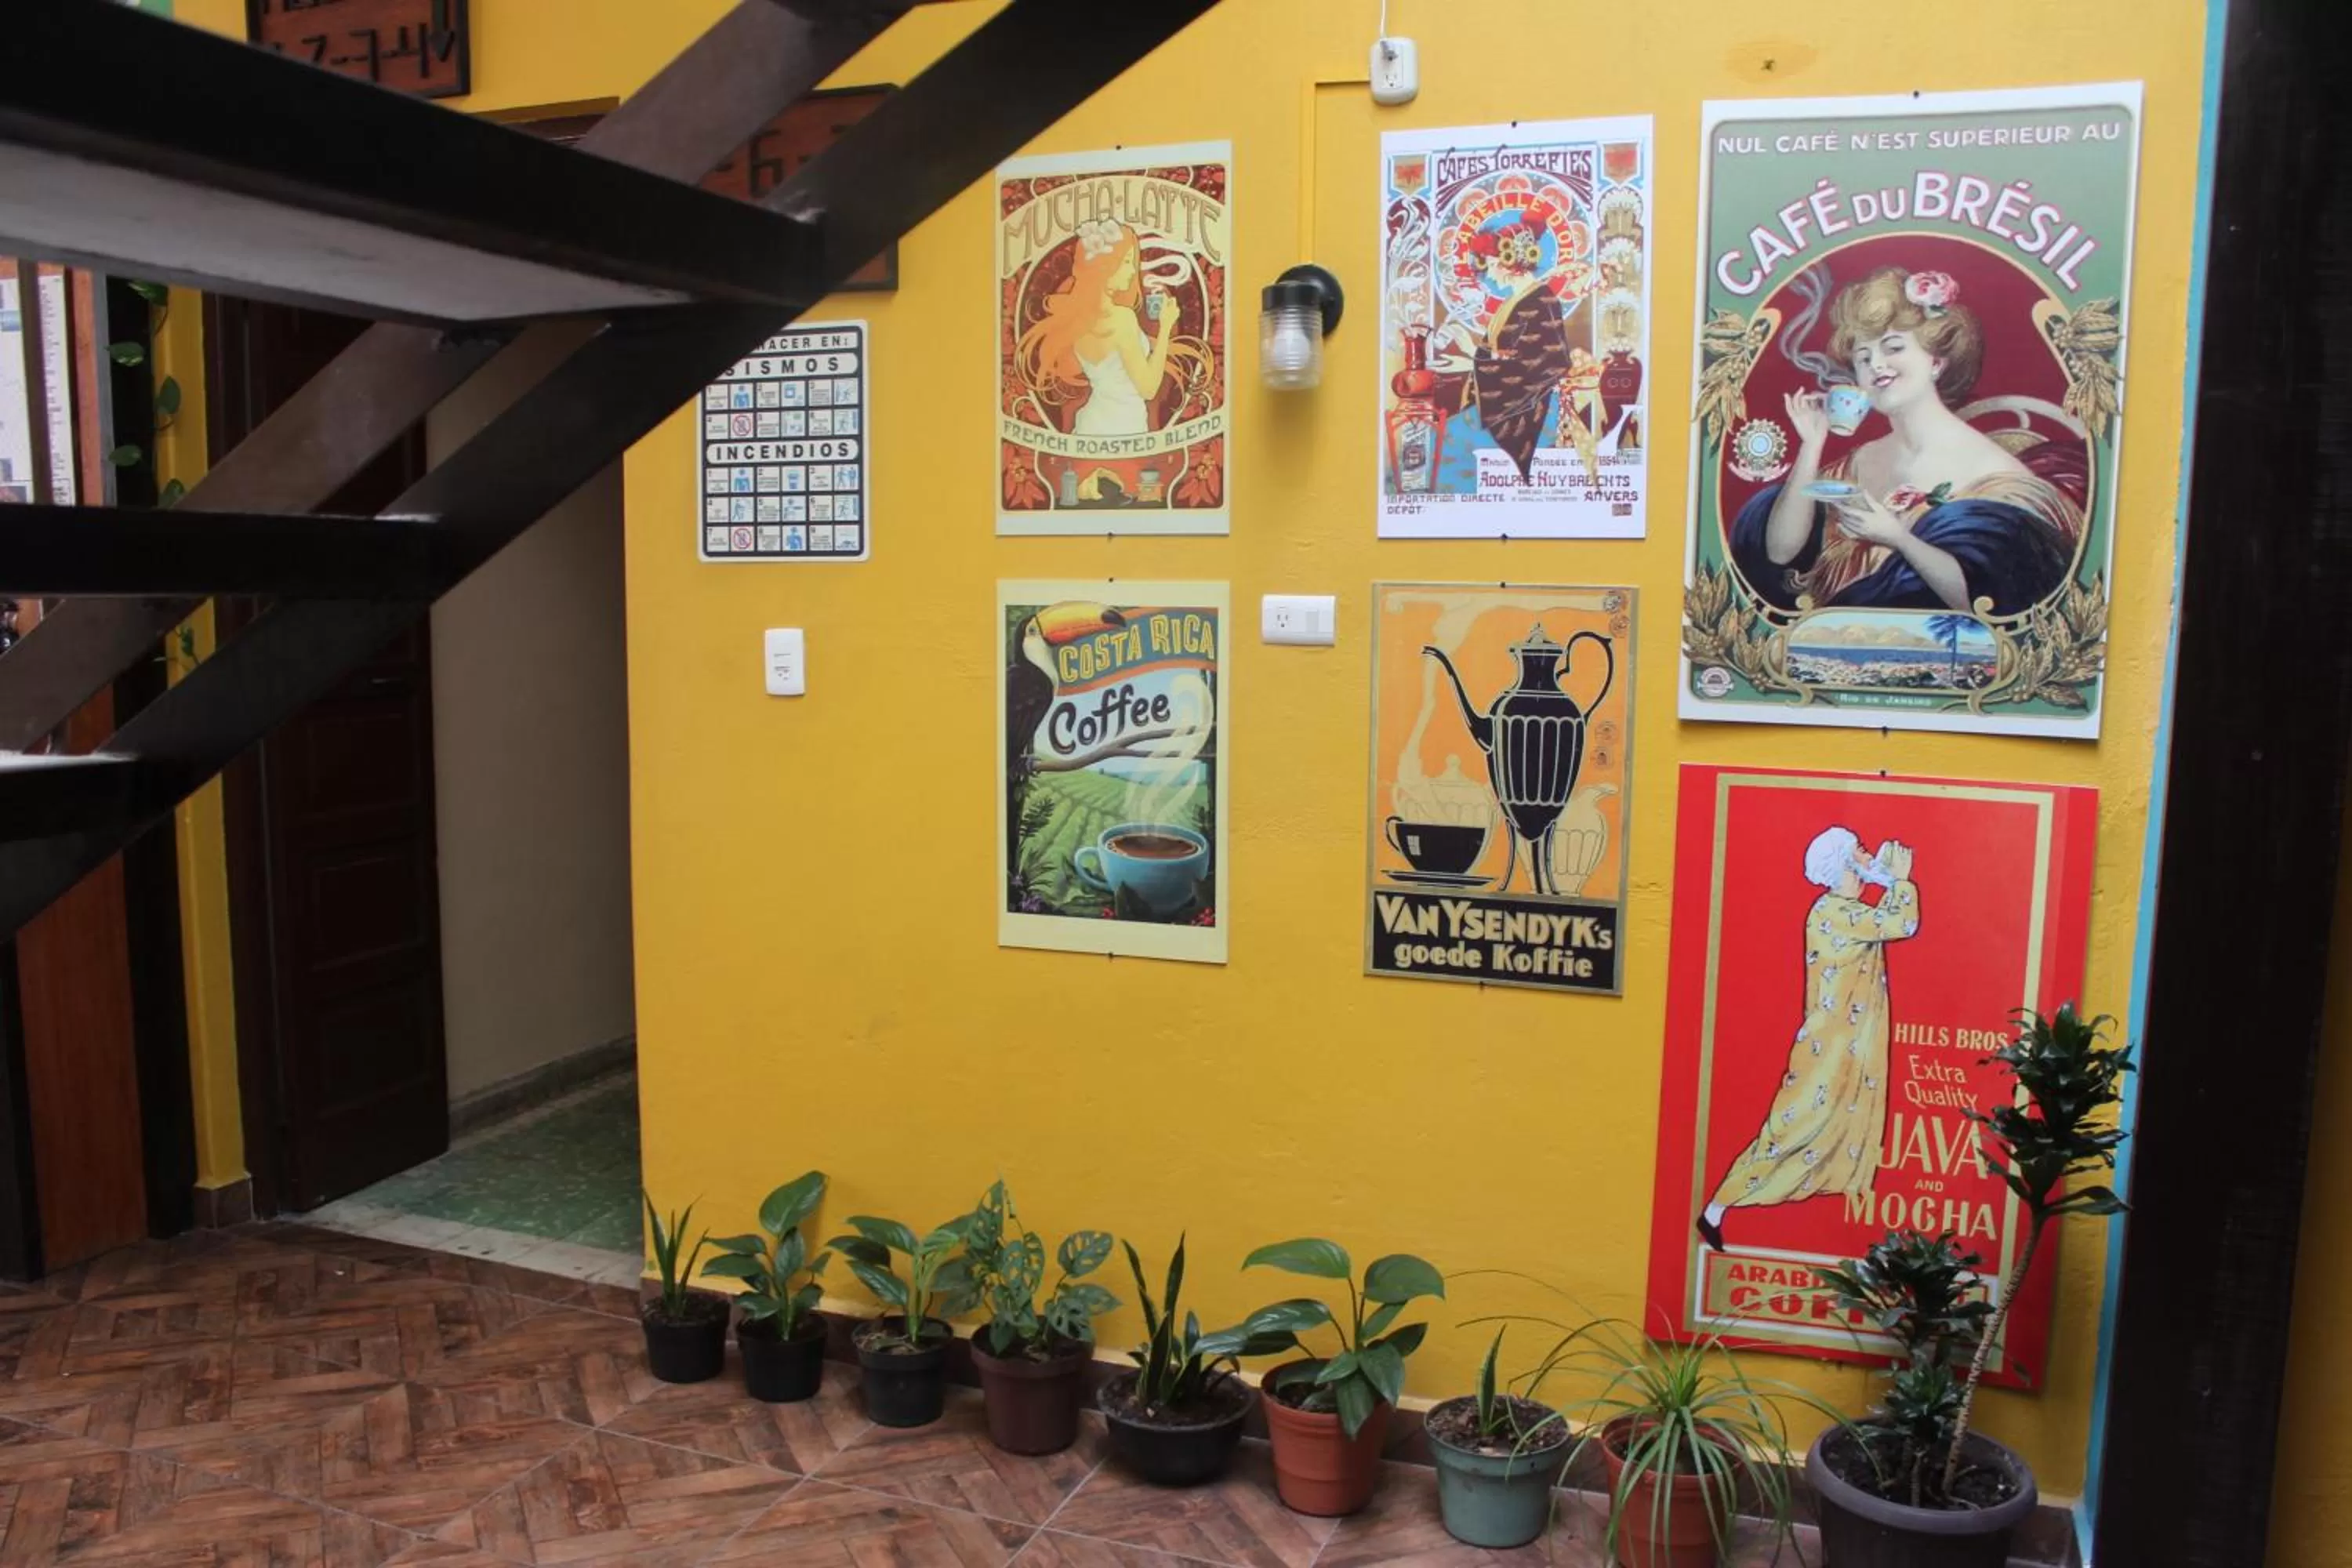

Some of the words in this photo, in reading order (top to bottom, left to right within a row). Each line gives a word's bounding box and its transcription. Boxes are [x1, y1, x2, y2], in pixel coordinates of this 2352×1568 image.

[1718, 136, 1766, 154] NUL
[1775, 129, 1839, 153] CAFÉ
[1850, 132, 1920, 151] N'EST
[2082, 122, 2121, 141] AU
[1715, 179, 1851, 297] CAFÉ
[1852, 187, 1907, 225] DU
[1913, 171, 2099, 292] BRÉSIL
[716, 442, 849, 460] INCENDIOS
[1004, 420, 1067, 452] FRENCH
[1076, 437, 1156, 455] ROASTED
[1165, 415, 1221, 446] BLEND
[1461, 494, 1504, 503] DIRECTE
[1584, 491, 1639, 502] ANVERS
[1059, 624, 1142, 683] COSTA
[1150, 615, 1214, 659] RICA
[1048, 684, 1171, 755] Coffee
[1394, 941, 1482, 968] goede
[1493, 942, 1593, 978] Koffie
[1894, 1022, 1950, 1047] HILLS
[1908, 1054, 1967, 1083] Extra
[1904, 1080, 1979, 1112] Quality
[1878, 1112, 1988, 1180] JAVA
[1915, 1178, 1944, 1192] AND
[1844, 1190, 1997, 1240] MOCHA
